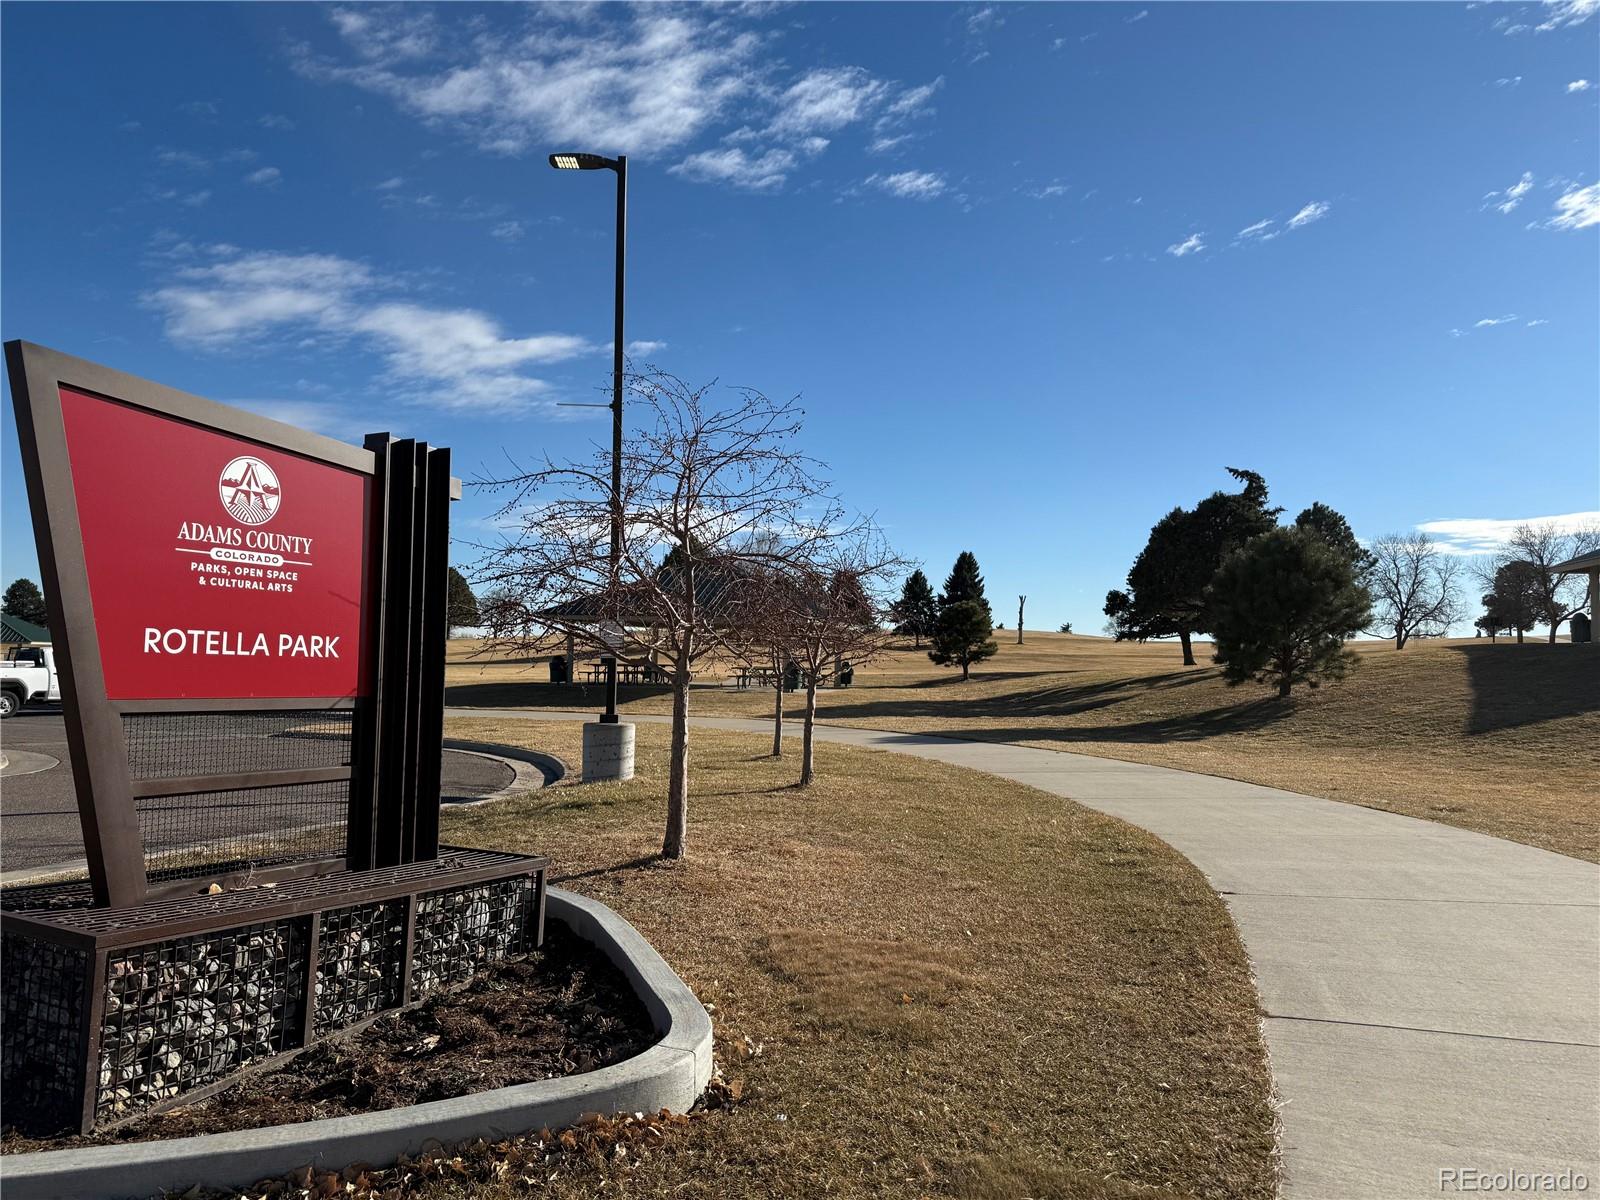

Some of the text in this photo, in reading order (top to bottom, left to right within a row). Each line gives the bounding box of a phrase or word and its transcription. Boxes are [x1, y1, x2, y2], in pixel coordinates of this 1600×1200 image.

[177, 521, 313, 555] ADAMS COUNTY
[215, 550, 280, 564] COLORADO
[191, 562, 298, 581] PARKS, OPEN SPACE
[198, 576, 293, 593] & CULTURAL ARTS
[143, 627, 340, 658] ROTELLA PARK
